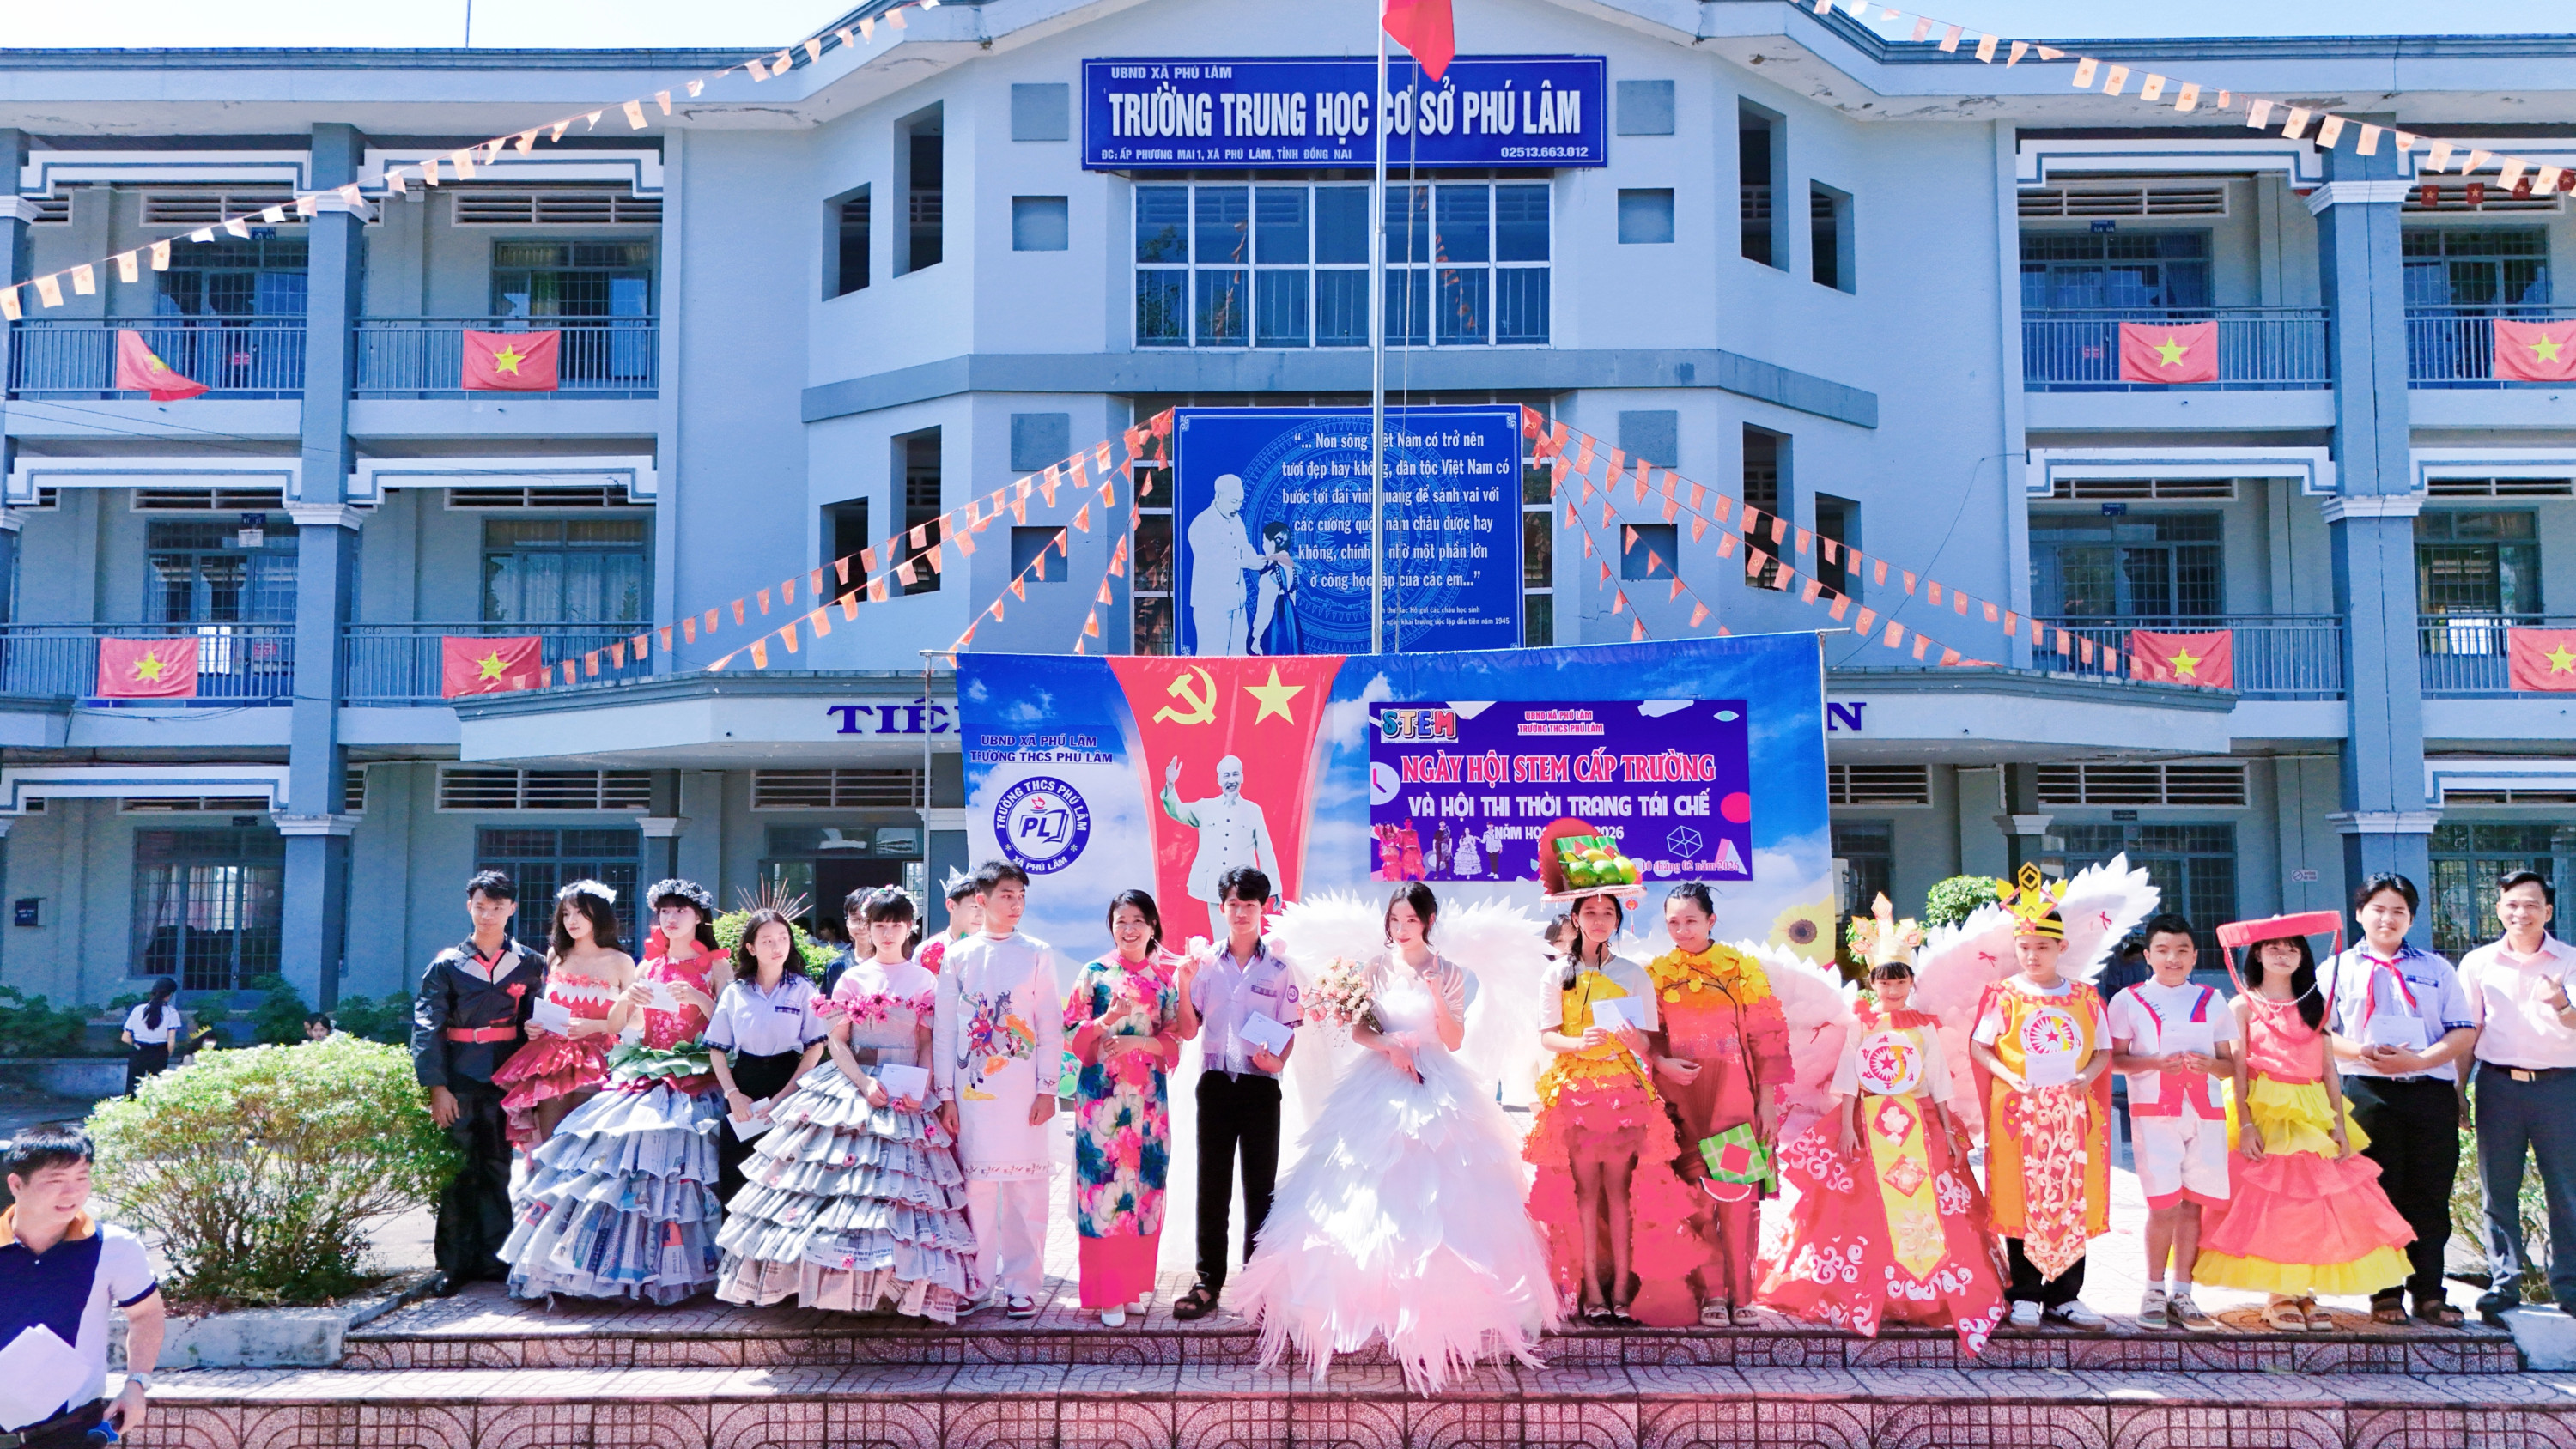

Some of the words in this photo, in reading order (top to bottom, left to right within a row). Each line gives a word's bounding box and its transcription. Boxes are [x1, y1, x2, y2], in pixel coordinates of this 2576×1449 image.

[1111, 66, 1146, 79] UBND
[1151, 64, 1169, 79] XÃ
[1174, 66, 1200, 79] PHÚ
[1205, 64, 1232, 79] LÂM
[1109, 81, 1212, 137] TRƯỜNG
[1220, 92, 1307, 137] TRUNG
[1316, 91, 1369, 145] HỌC
[1419, 76, 1455, 136] SỞ
[1462, 80, 1515, 136] PHÚ
[1523, 80, 1581, 135] LÂM
[1119, 146, 1132, 160] ẤP
[1136, 148, 1173, 160] PHƯƠNG
[1207, 147, 1220, 160] XÃ
[1249, 147, 1274, 161] LÂM,
[1277, 146, 1298, 160] TỈNH
[1334, 149, 1352, 160] NAI
[1501, 146, 1589, 158] 02513.663.012
[1315, 434, 1337, 448] Non
[1340, 433, 1368, 451] sông
[1397, 432, 1422, 447] Nam
[1425, 432, 1438, 446] có
[1443, 430, 1459, 446] trở
[1463, 433, 1484, 446] nên
[1282, 461, 1303, 476] tươi
[1307, 461, 1327, 478] đẹp
[1331, 461, 1349, 478] hay
[1354, 460, 1392, 478] khôg,
[1396, 460, 1416, 475] dân
[1419, 461, 1438, 477] tộc
[1442, 460, 1464, 477] Việt
[1467, 459, 1492, 475] Nam
[1496, 458, 1510, 475] có
[1283, 488, 1309, 504] bước
[1313, 488, 1328, 504] tới
[1332, 488, 1350, 504] đài
[1352, 488, 1373, 504] vinh
[1416, 484, 1429, 503] để
[1432, 488, 1459, 503] sánh
[1463, 488, 1479, 502] vai
[1483, 487, 1500, 502] với
[1294, 517, 1314, 532] các
[1317, 517, 1352, 534] cường
[1355, 517, 1374, 534] quố
[1385, 516, 1409, 530] năm
[1413, 515, 1440, 530] châu
[1443, 515, 1470, 533] được
[1474, 515, 1493, 533] hay
[1298, 543, 1337, 562] không,
[1340, 543, 1371, 560] chính
[1388, 543, 1410, 559] nhờ
[1413, 545, 1435, 562] một
[1439, 541, 1467, 561] phần
[1470, 543, 1488, 558] lớn
[1309, 570, 1318, 587] ở
[1321, 573, 1348, 591] công
[1352, 571, 1373, 591] học
[1382, 571, 1395, 591] ập
[1400, 569, 1419, 587] của
[1423, 572, 1443, 587] các
[1468, 605, 1480, 614] sinh
[1495, 616, 1510, 626] 1945
[827, 696, 960, 733] TIÊ
[1525, 711, 1546, 721] UBND
[1546, 709, 1558, 721] XÃ
[1558, 709, 1574, 721] PHÚ
[1576, 709, 1593, 721] LÂM
[1518, 722, 1547, 733] TRƯỜNG
[1548, 724, 1569, 733] THCS
[1570, 722, 1585, 733] PHÚ
[1586, 722, 1604, 733] LÂM
[981, 735, 1016, 746] UBND
[1019, 733, 1036, 746] XÃ
[1040, 733, 1066, 746] PHÚ
[1070, 733, 1097, 747] LÂM
[970, 749, 1016, 762] TRƯỜNG
[1019, 751, 1052, 762] THCS
[1056, 749, 1082, 763] PHÚ
[1086, 749, 1113, 763] LÂM
[1401, 749, 1465, 783] NGÀY
[1467, 749, 1510, 789] HỘI
[1513, 755, 1570, 783] STEM
[1574, 746, 1617, 783] CẤP
[1620, 749, 1716, 782] TRƯỜNG
[997, 787, 1025, 830] TRƯỜNG
[1024, 779, 1056, 792] THCS
[1056, 785, 1082, 805] PHÚ
[1073, 805, 1090, 832] LÂM
[1407, 791, 1435, 816] VÀ
[1441, 791, 1474, 822] HỘI
[1480, 796, 1510, 816] THI
[1516, 791, 1561, 816] THỜI
[1567, 796, 1632, 816] TRANG
[1638, 791, 1668, 816] TÁI
[1674, 788, 1710, 816] CHẾ
[1020, 817, 1051, 838] PL
[1494, 823, 1522, 840] NĂM
[1025, 861, 1047, 872] PHÚ
[1047, 856, 1069, 870] LÂM
[1642, 860, 1652, 871] 10
[1654, 859, 1681, 874] tháng
[1682, 859, 1693, 871] 02
[1695, 859, 1716, 871] năm
[1718, 859, 1739, 871] 2026
